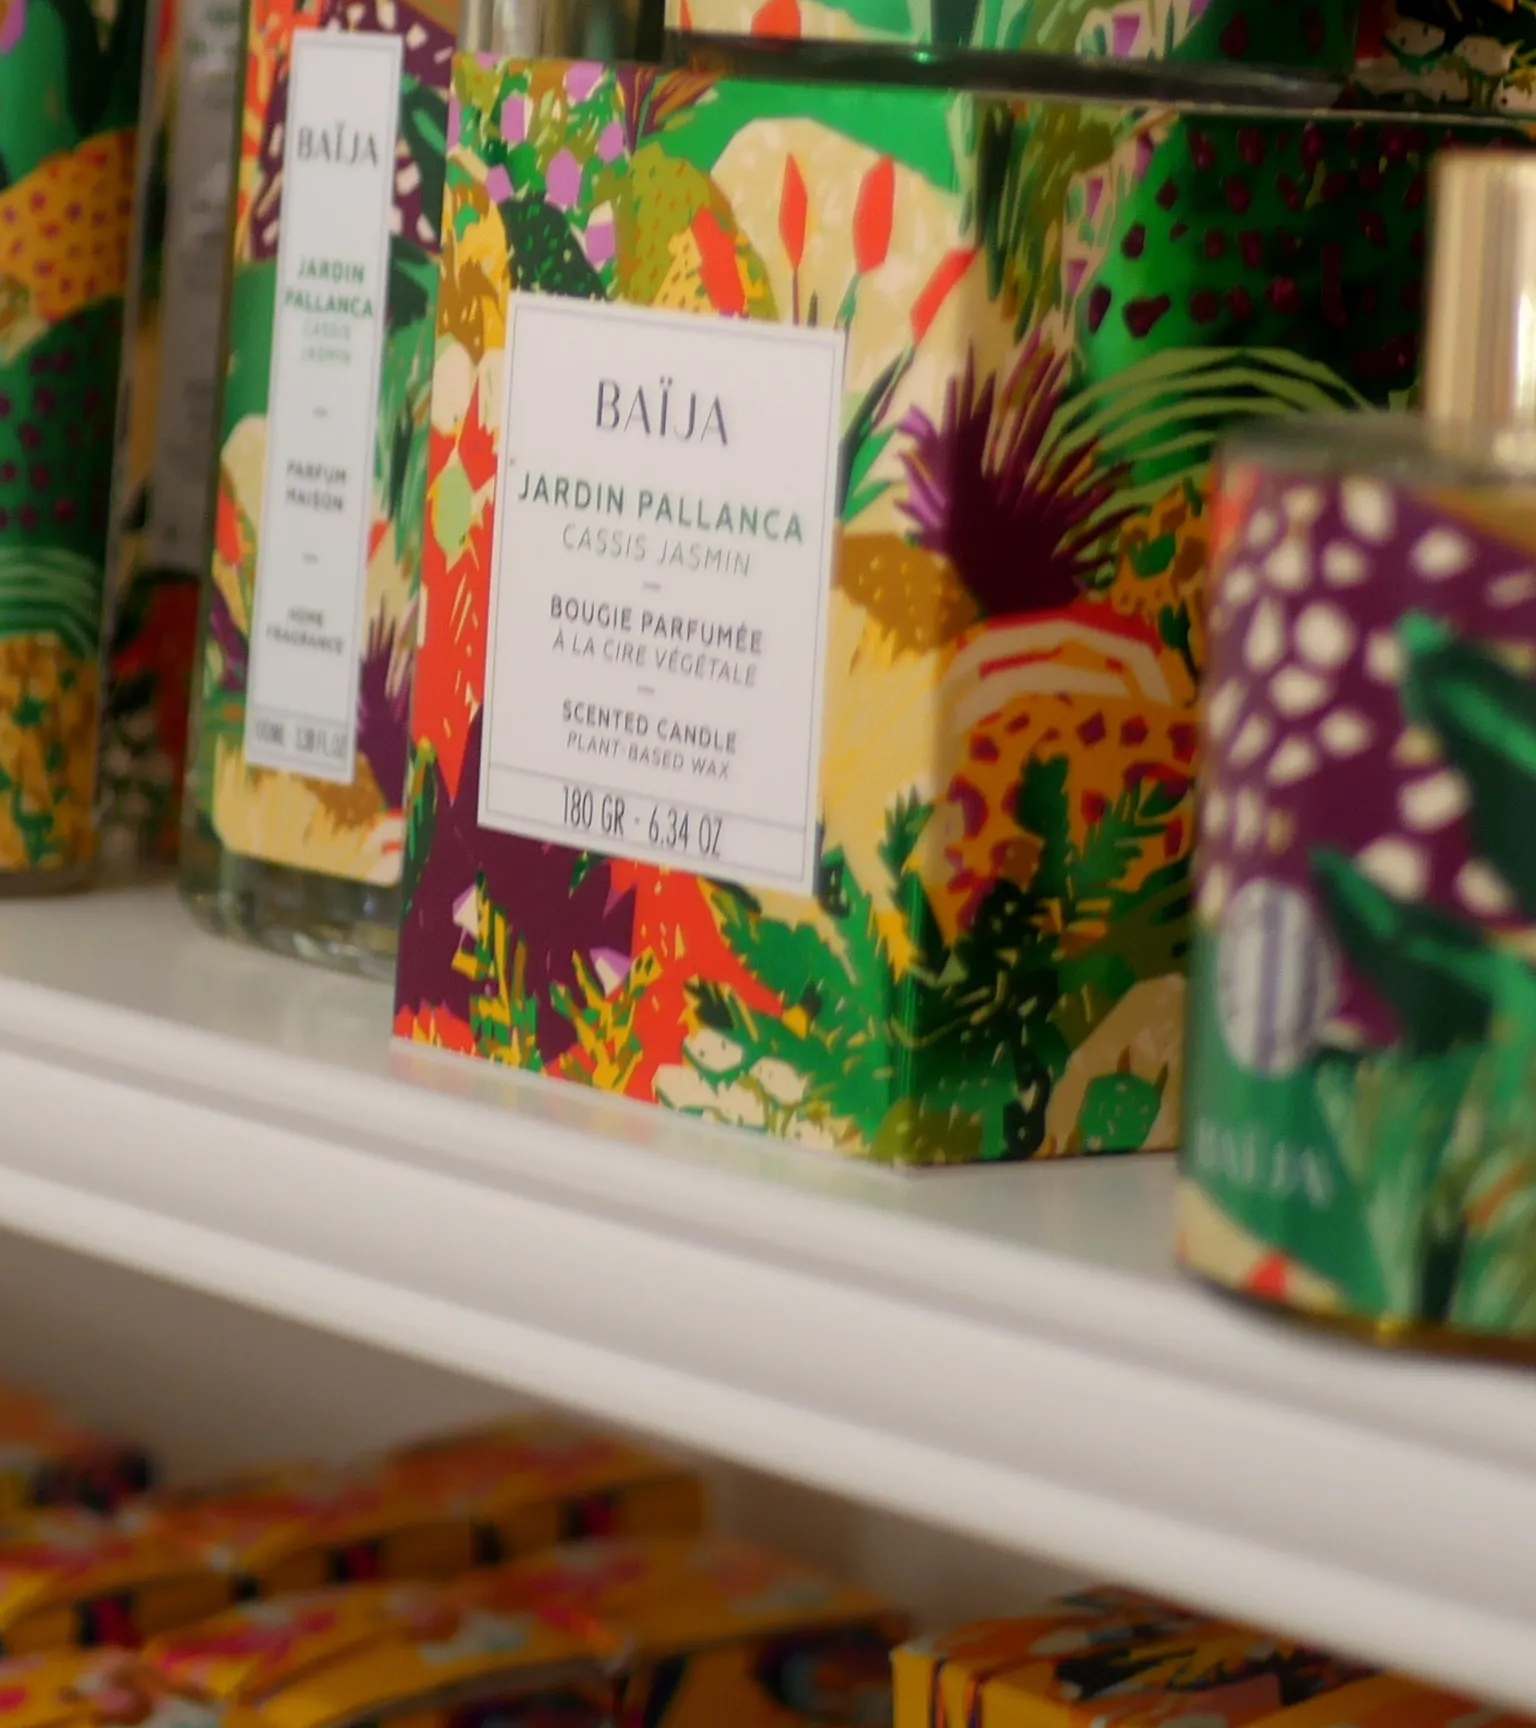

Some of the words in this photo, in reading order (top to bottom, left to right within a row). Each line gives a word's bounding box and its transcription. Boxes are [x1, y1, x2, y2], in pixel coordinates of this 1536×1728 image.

[297, 121, 379, 168] BAÏJA
[298, 257, 365, 286] JARDIN
[284, 288, 374, 317] PALLANCA
[596, 374, 729, 447] BAÏJA
[517, 471, 626, 517] JARDIN
[637, 489, 805, 545] PALLANCA
[562, 523, 648, 562] CASSIS
[656, 538, 752, 577] JASMIN
[550, 593, 633, 632] BOUGIE
[640, 610, 763, 655] PARFUMÉE
[571, 633, 595, 657] LA
[602, 637, 648, 668] CIRE
[654, 646, 759, 688] VÉGÉTALE
[562, 699, 649, 737] SCENTED
[656, 718, 737, 755] CANDLE
[566, 729, 685, 771] PLANT-BASED
[691, 756, 730, 780] WAX
[563, 784, 594, 831] 180
[601, 792, 626, 838] GR
[648, 804, 690, 852] 6.34
[698, 814, 724, 859] OZ
